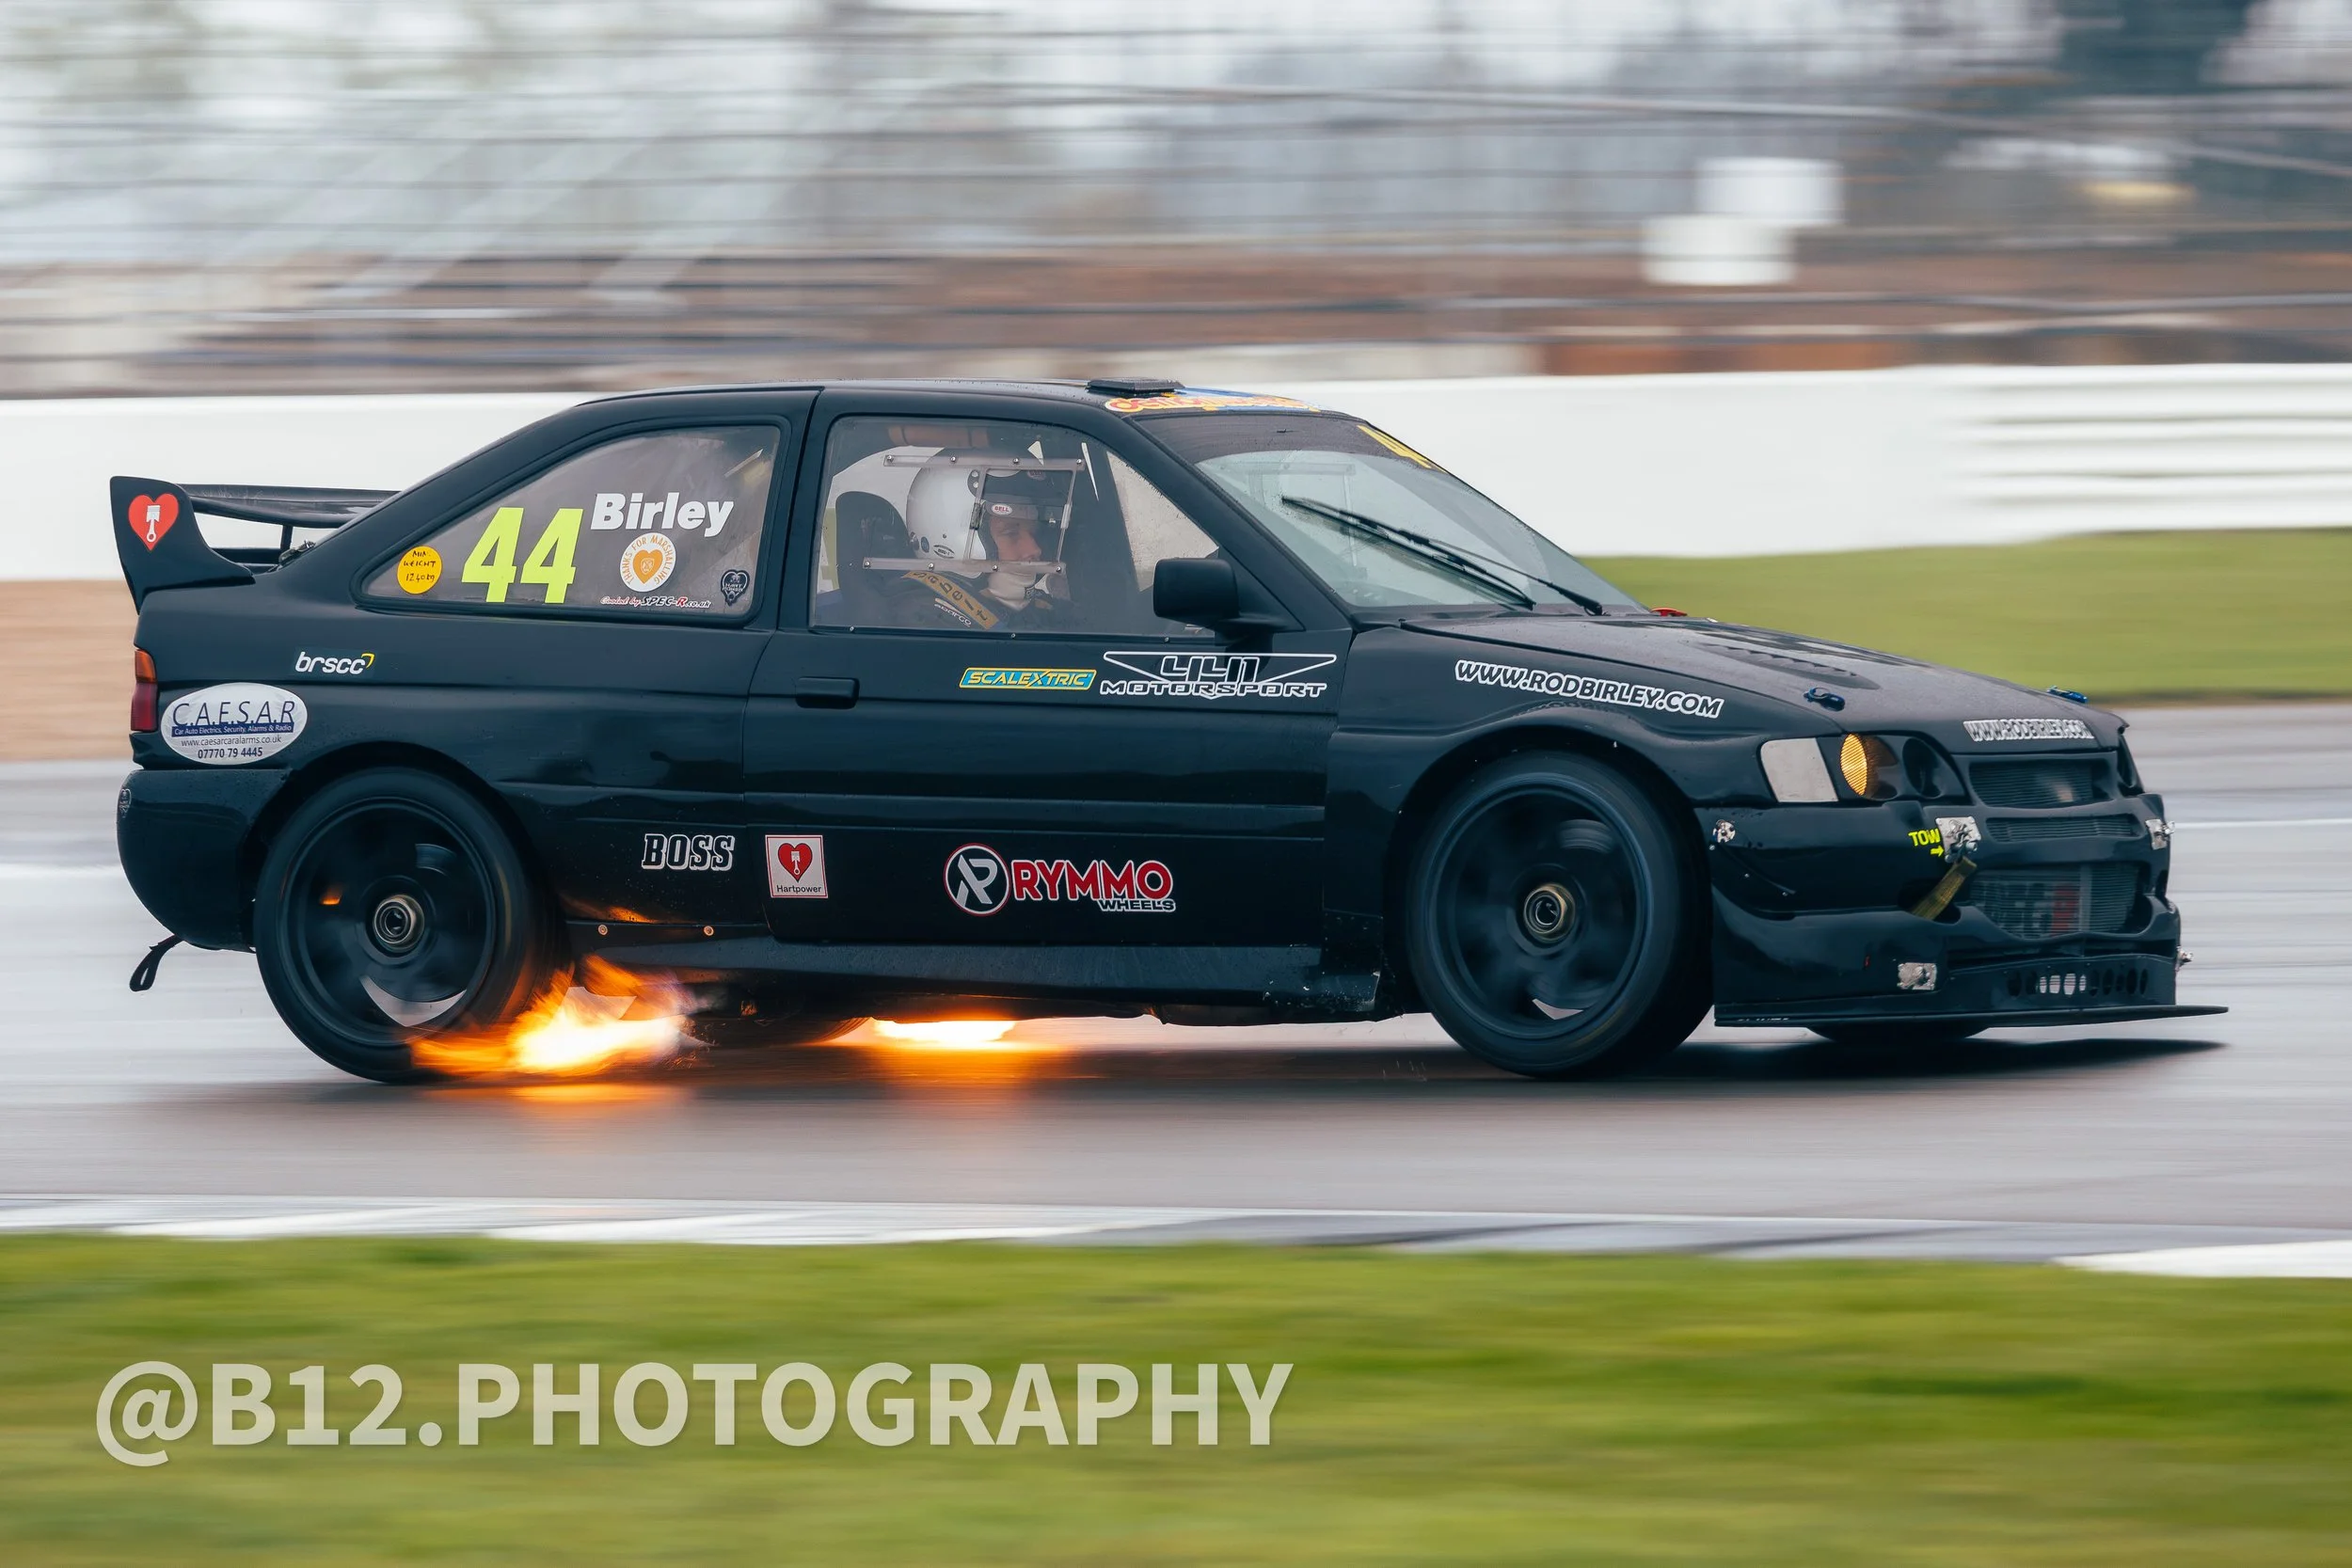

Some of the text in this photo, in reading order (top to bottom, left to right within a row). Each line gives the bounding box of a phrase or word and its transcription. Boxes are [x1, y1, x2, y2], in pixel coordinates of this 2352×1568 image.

[591, 492, 734, 537] Birley
[461, 507, 583, 603] 44
[622, 552, 634, 584] THANKS
[631, 536, 646, 550] FOR
[294, 651, 366, 674] brscc
[967, 672, 1089, 687] SCALEXTRIC
[1100, 680, 1327, 698] MOTORSPORT
[1454, 659, 1724, 719] WWW.RODBIRLEY.COM
[173, 701, 295, 726] C.A.E.S.A.R
[275, 723, 292, 732] Radio
[181, 735, 282, 747] www.caesarcaralarms.co.uk
[198, 748, 262, 759] 07770 79 4445
[1908, 829, 1941, 847] TOW
[642, 833, 736, 871] BOSS
[776, 884, 822, 895] Hartpower
[1011, 859, 1173, 901] RYMMO
[1097, 897, 1176, 912] WHEELS
